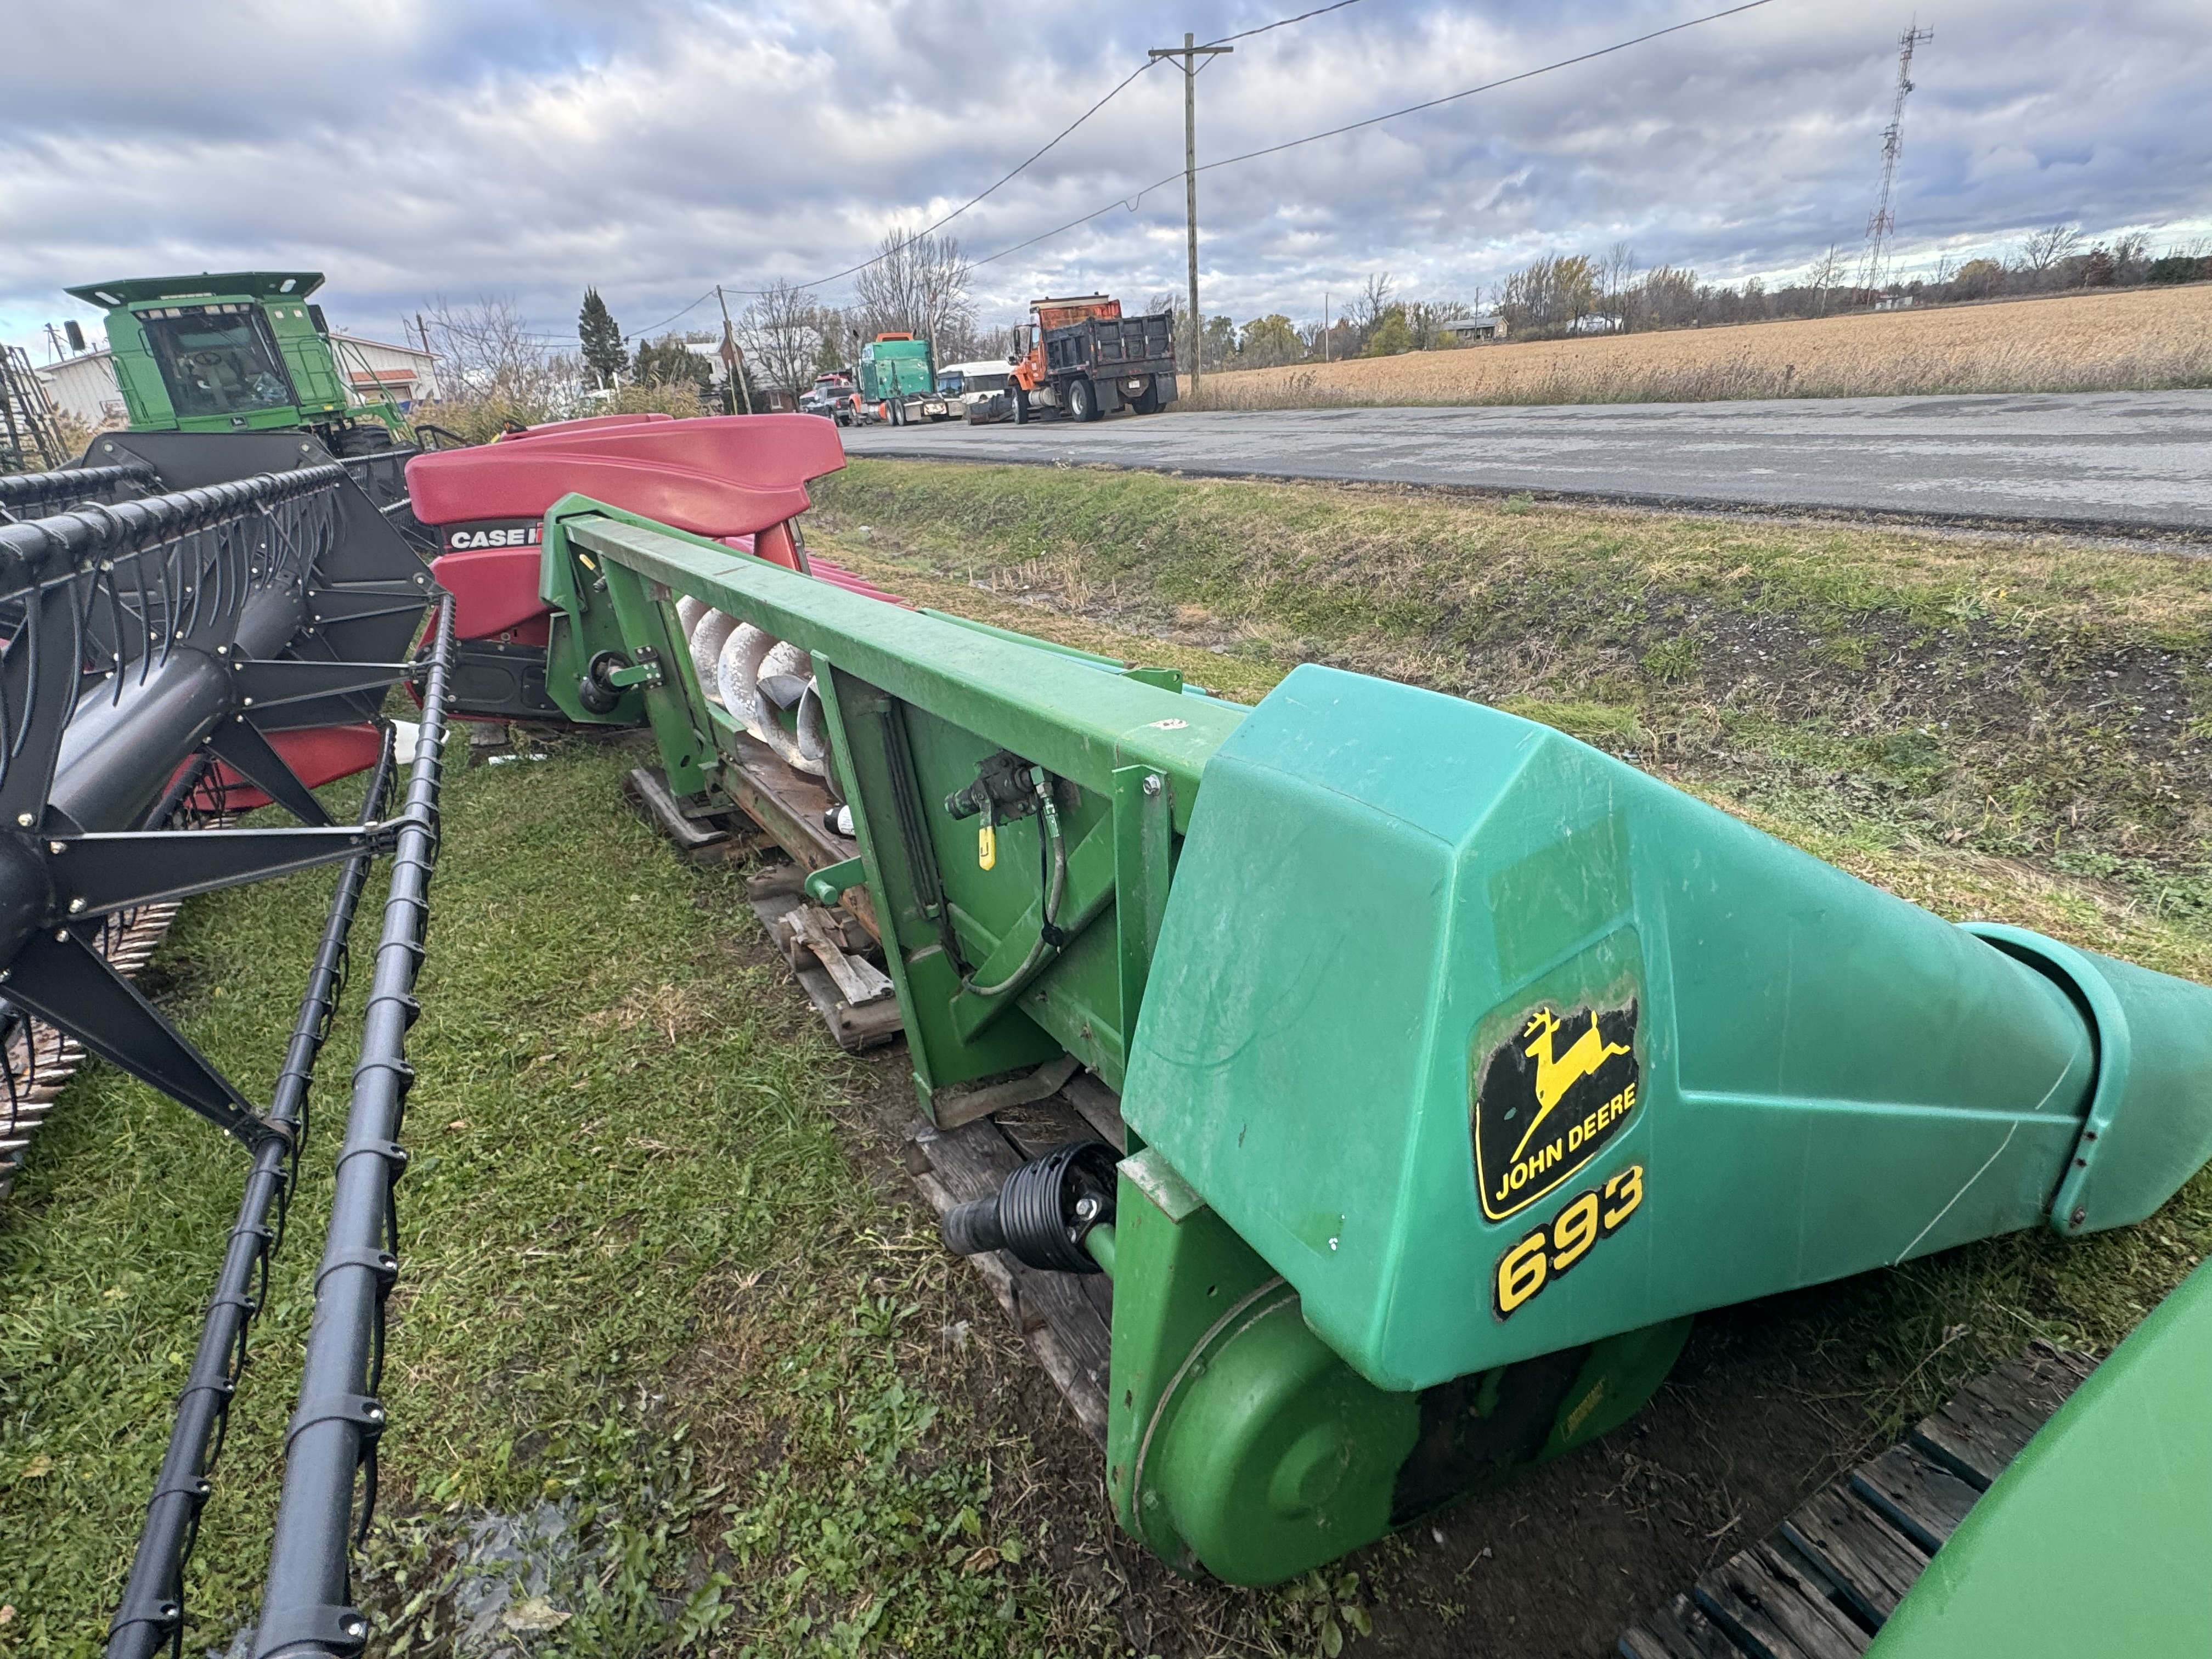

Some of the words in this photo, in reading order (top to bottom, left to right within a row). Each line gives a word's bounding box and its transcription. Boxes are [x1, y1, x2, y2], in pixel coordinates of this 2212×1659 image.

[451, 529, 524, 548] CASE
[1496, 1138, 1562, 1200] JOHN
[1568, 1082, 1635, 1152] DEERE
[1498, 1165, 1643, 1312] 693
